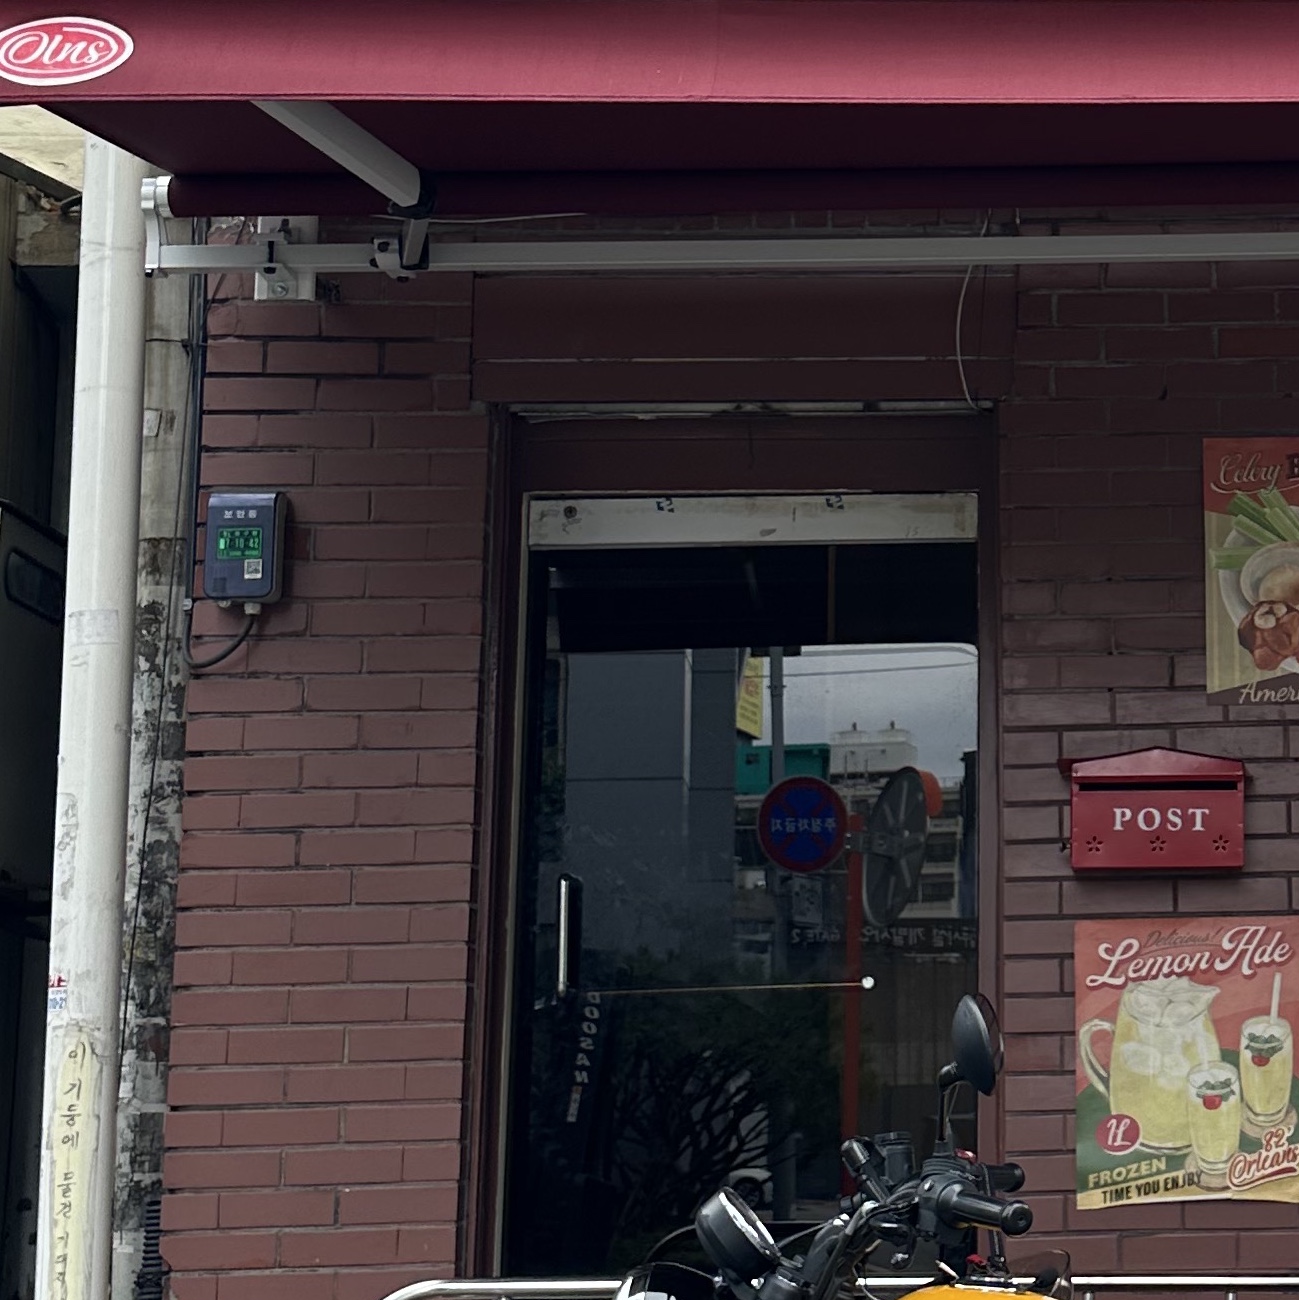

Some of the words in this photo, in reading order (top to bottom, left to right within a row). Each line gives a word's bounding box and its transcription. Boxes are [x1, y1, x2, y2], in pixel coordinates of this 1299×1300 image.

[1218, 452, 1283, 489] Celery
[1113, 807, 1210, 832] POST
[1086, 938, 1213, 987] Lemon
[1213, 925, 1292, 976] Ade
[1088, 1156, 1167, 1190] FROZEN
[1101, 1185, 1133, 1205] TIME
[1135, 1180, 1161, 1197] YOU
